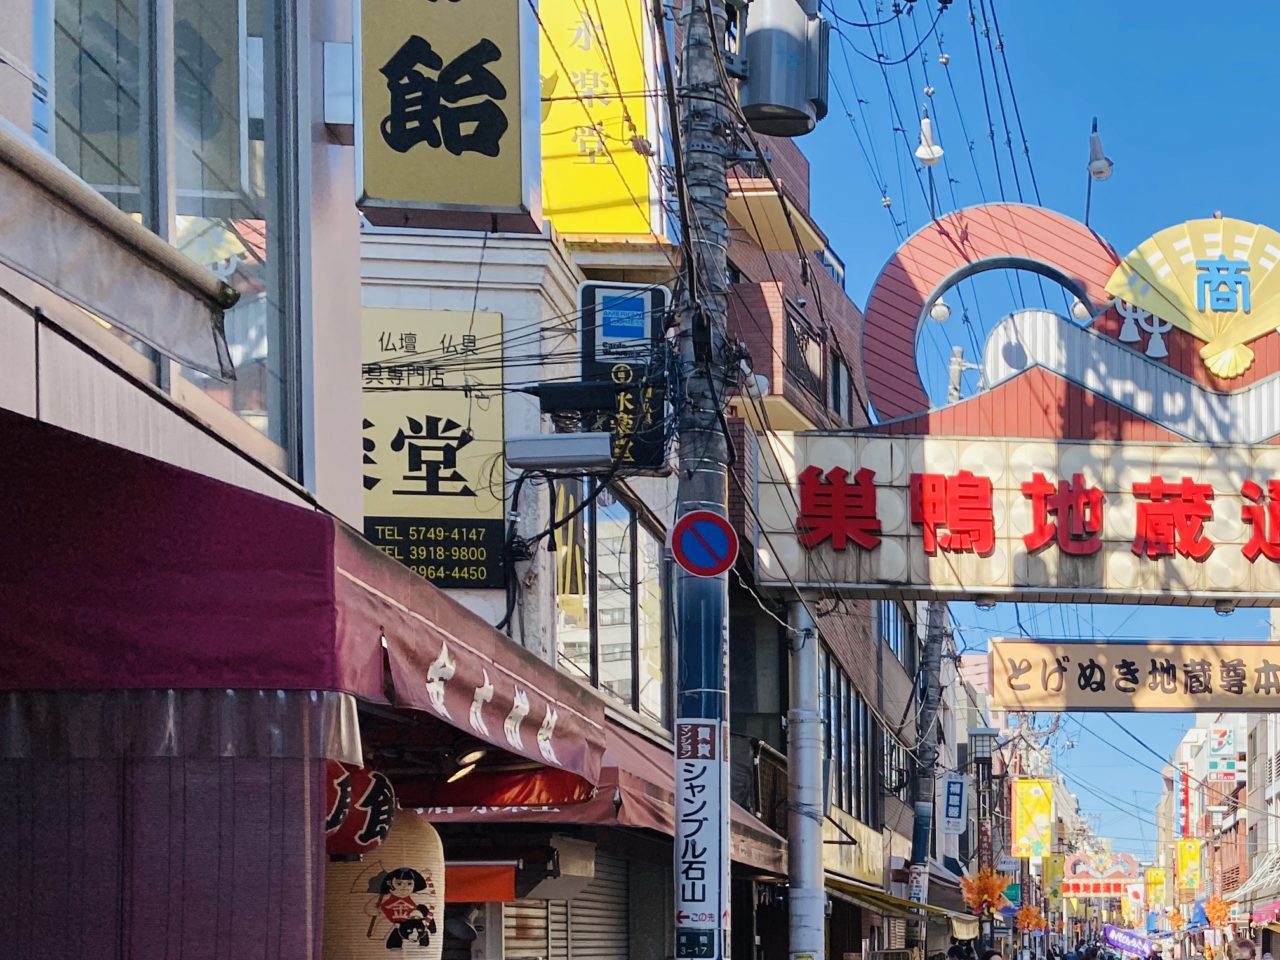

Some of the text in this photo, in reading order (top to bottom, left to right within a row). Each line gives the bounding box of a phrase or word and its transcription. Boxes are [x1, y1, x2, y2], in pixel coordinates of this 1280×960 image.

[379, 35, 508, 157] 飴
[1196, 254, 1251, 314] 商
[378, 331, 477, 354] 仏壇 仏具
[374, 526, 486, 541] TEL 5749-4147
[410, 545, 487, 560] 3918-9800
[680, 762, 709, 903] シャンブル石山
[386, 899, 415, 920] 金
[680, 947, 707, 955] 3-17
